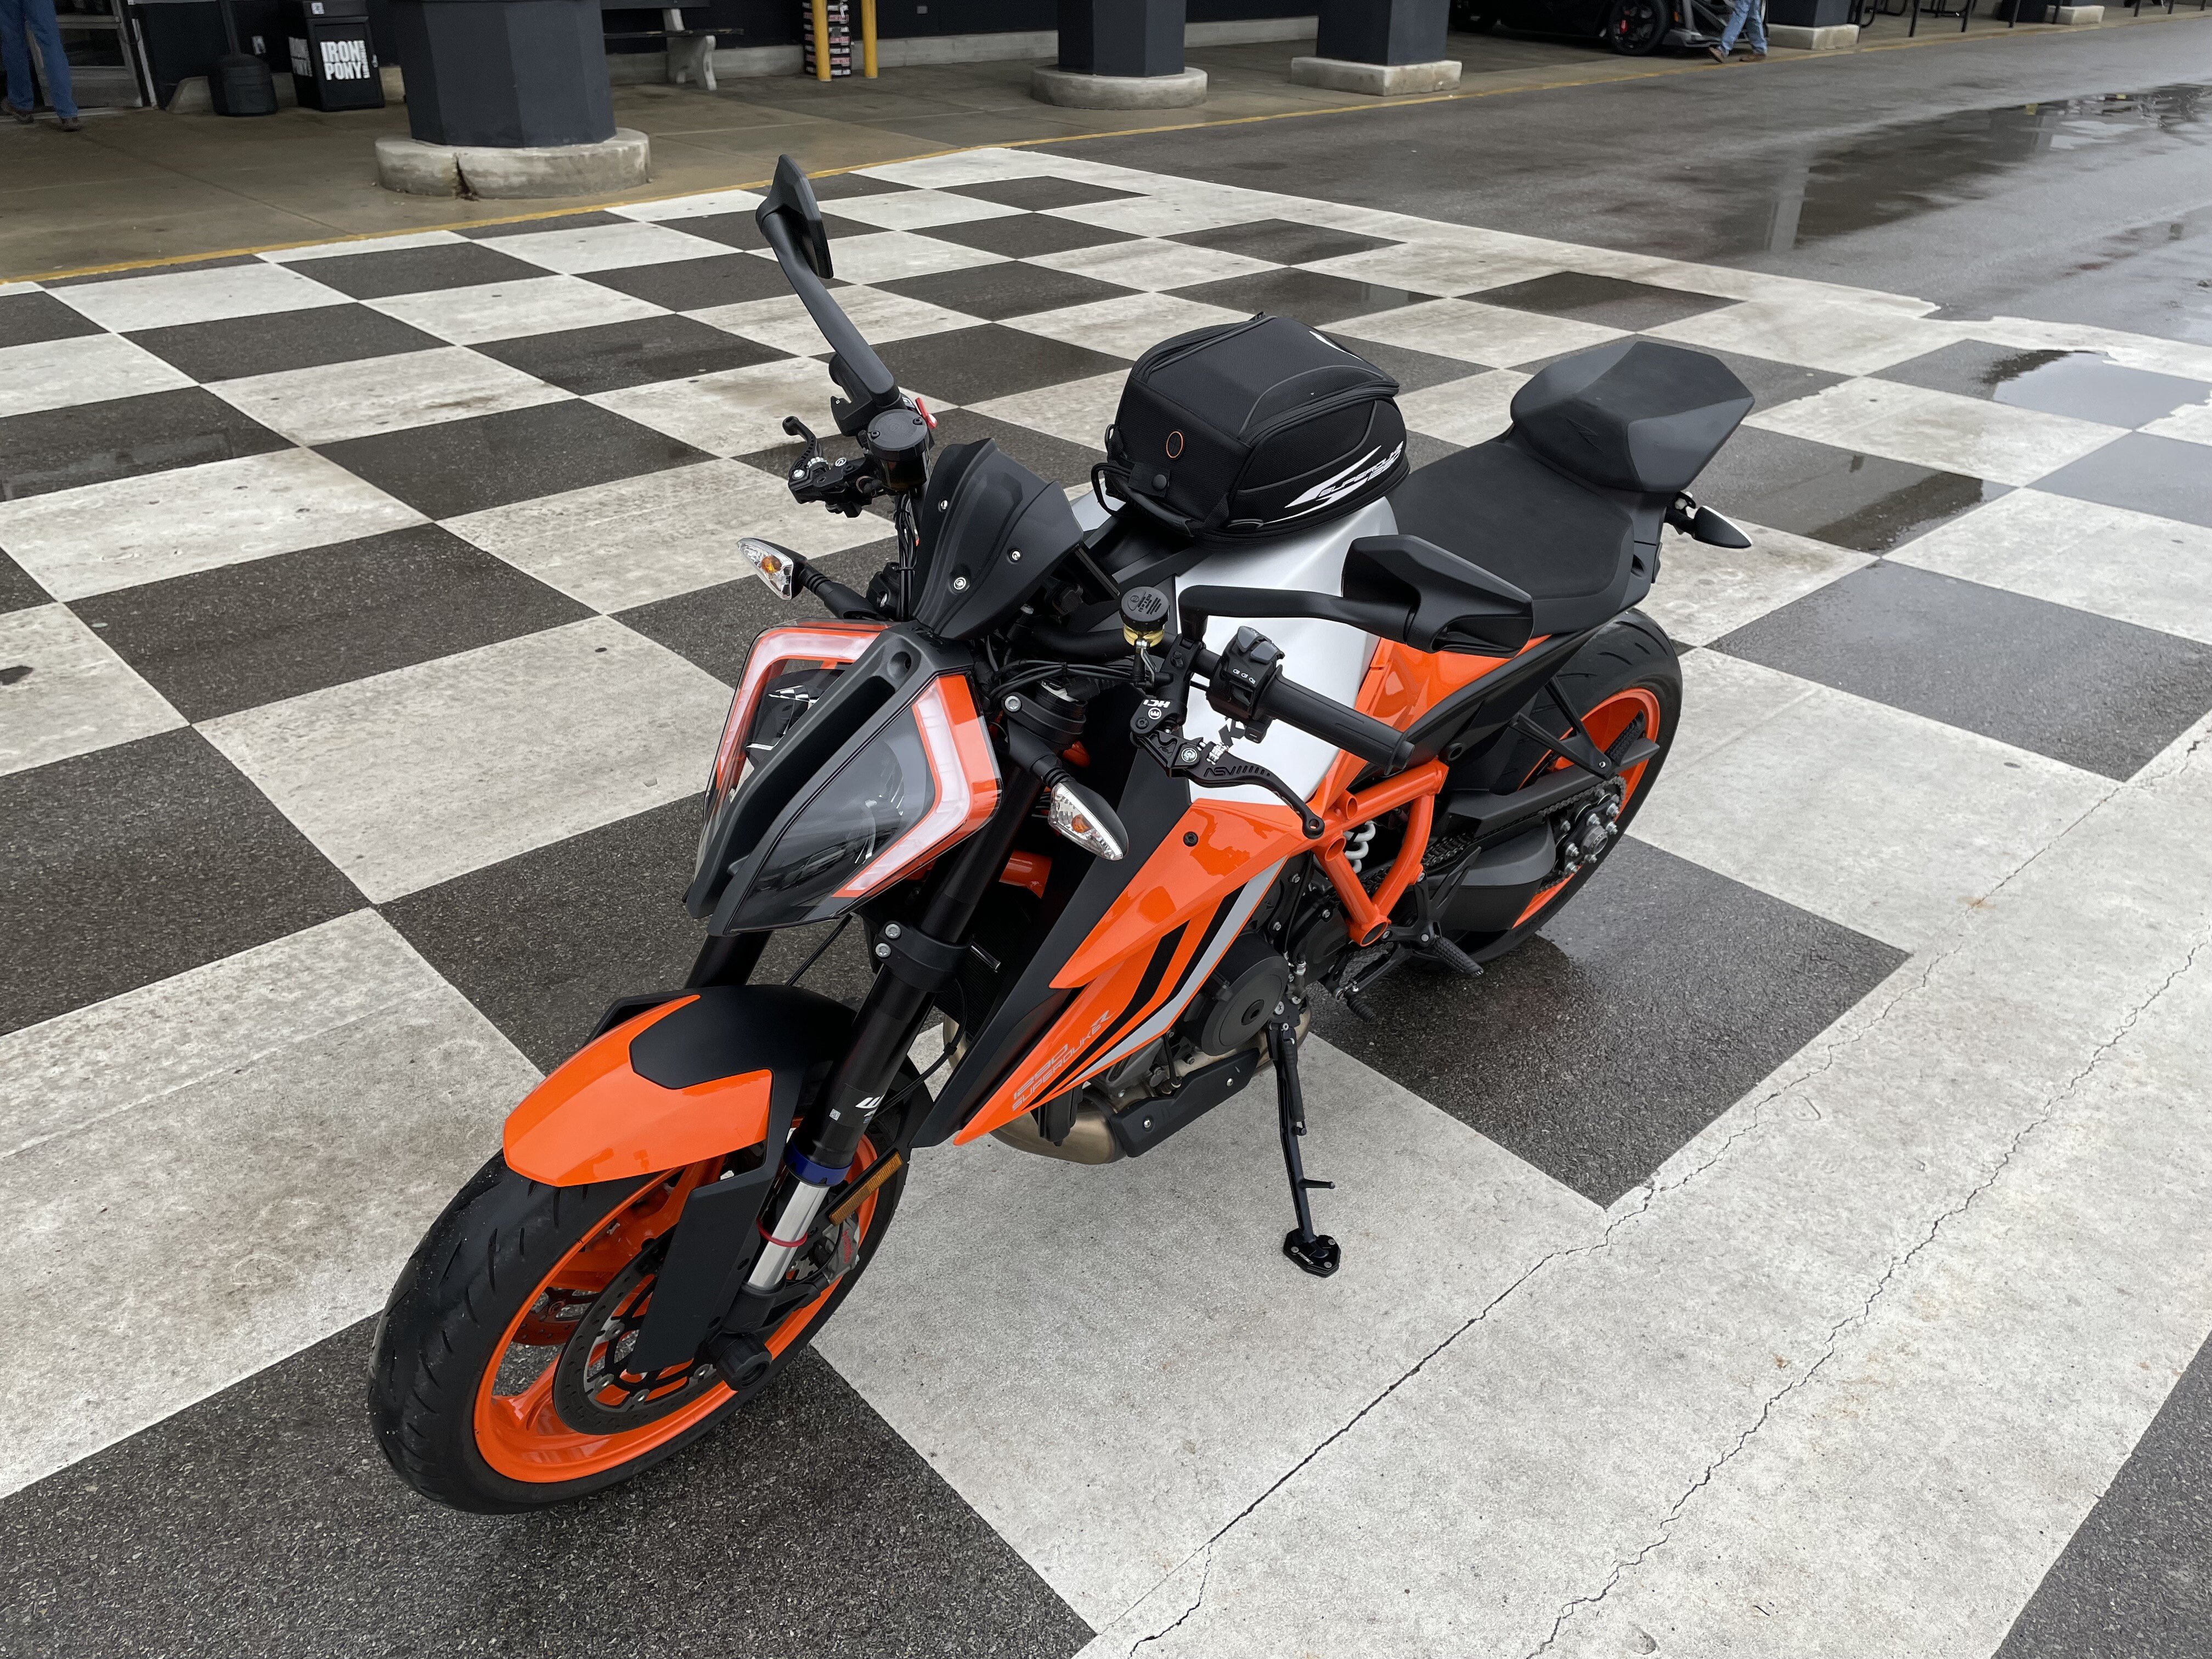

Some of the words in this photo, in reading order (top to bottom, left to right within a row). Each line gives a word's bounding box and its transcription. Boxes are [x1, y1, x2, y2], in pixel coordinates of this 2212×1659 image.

[320, 40, 360, 61] IRON
[324, 61, 362, 80] PONY
[1204, 766, 1237, 777] ASV
[1012, 1024, 1102, 1111] SUPERDUKE
[1013, 1043, 1068, 1101] 1290
